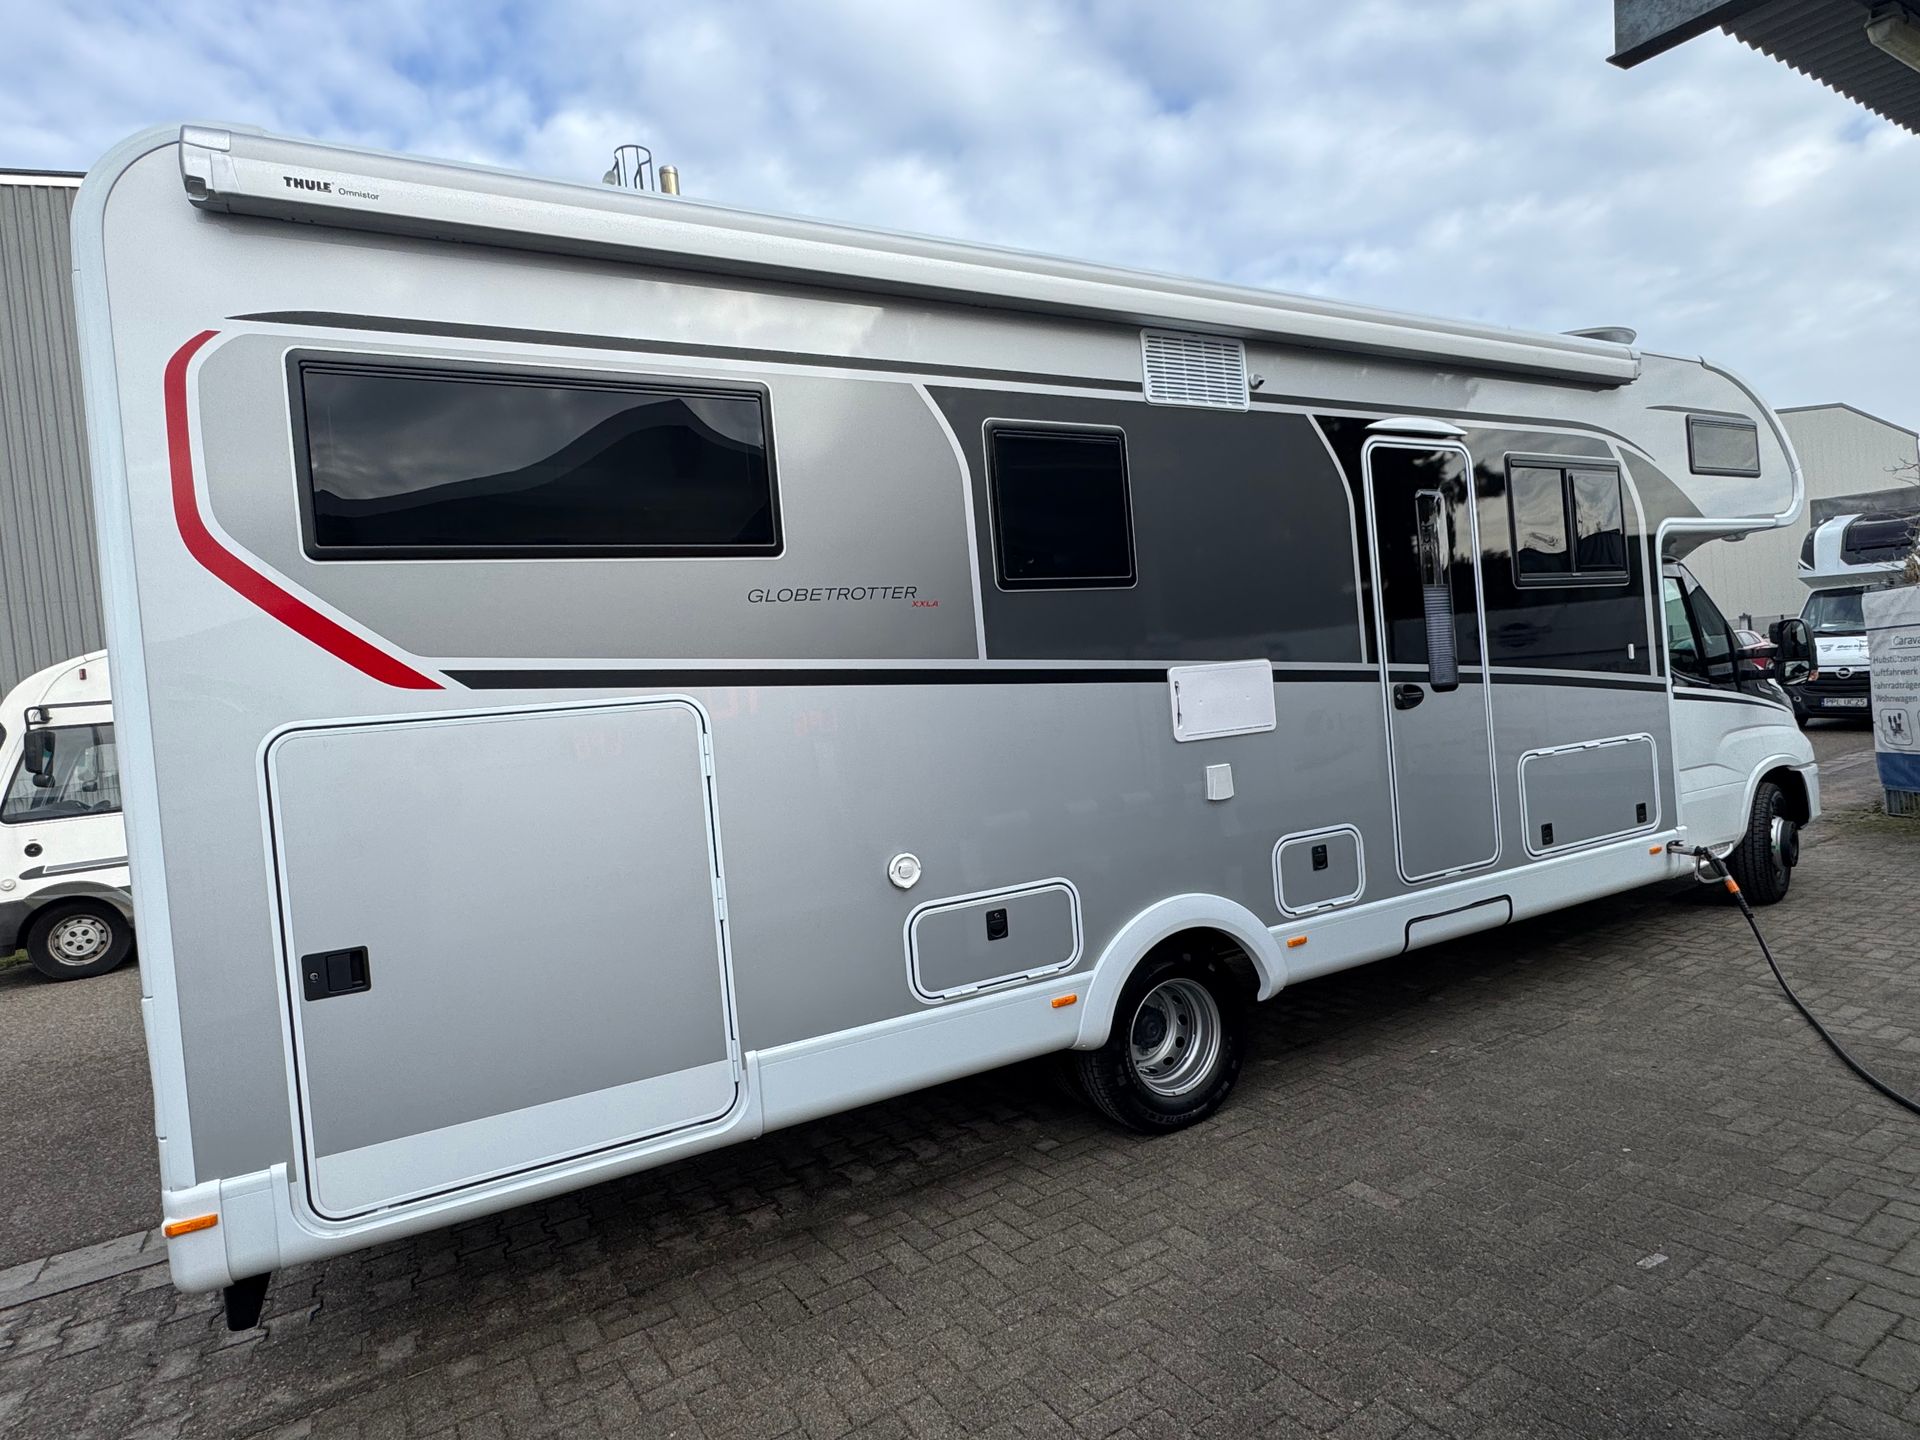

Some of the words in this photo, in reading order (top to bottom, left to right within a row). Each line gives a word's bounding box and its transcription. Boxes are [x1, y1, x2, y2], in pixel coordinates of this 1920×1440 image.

[282, 176, 332, 193] THULE
[338, 187, 380, 200] Omnistor
[747, 586, 918, 604] GLOBETROTTER
[911, 600, 939, 608] XXLA
